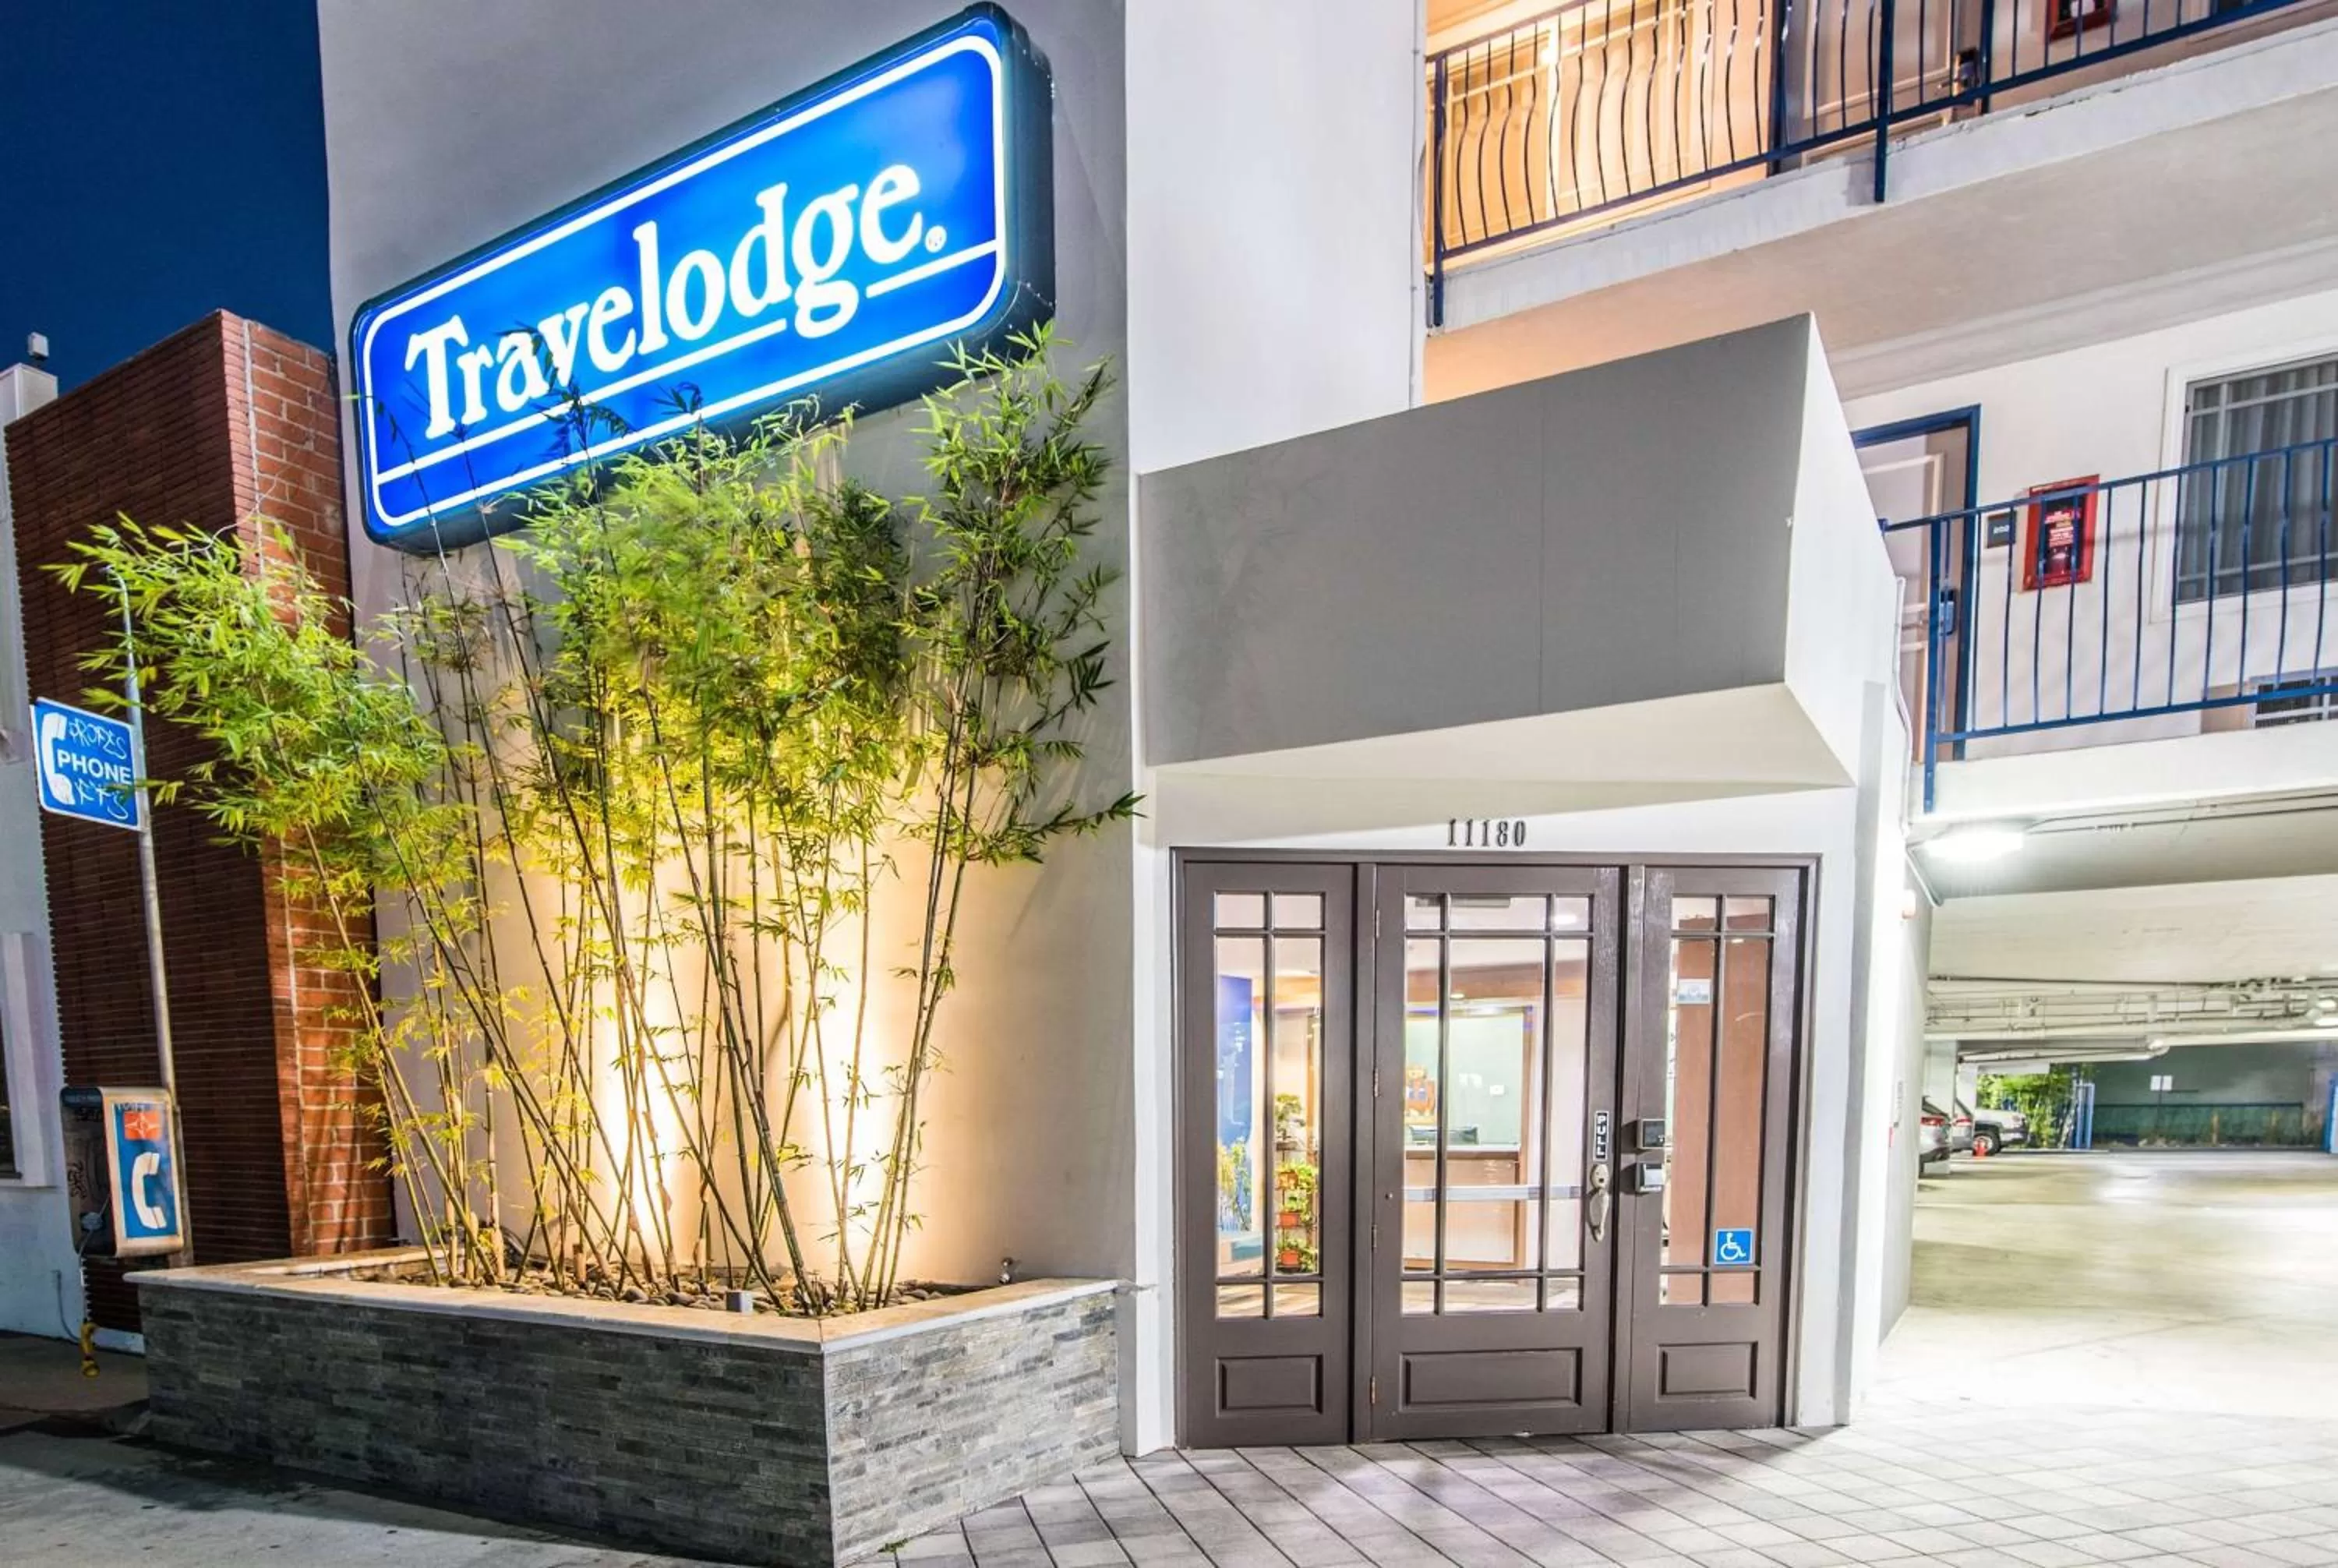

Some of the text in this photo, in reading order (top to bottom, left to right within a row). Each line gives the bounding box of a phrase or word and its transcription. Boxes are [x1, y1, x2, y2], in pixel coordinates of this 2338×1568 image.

[404, 164, 923, 439] Travelodge
[57, 749, 132, 785] PHONE
[1448, 818, 1526, 846] 11180
[1597, 1115, 1607, 1156] PULL
